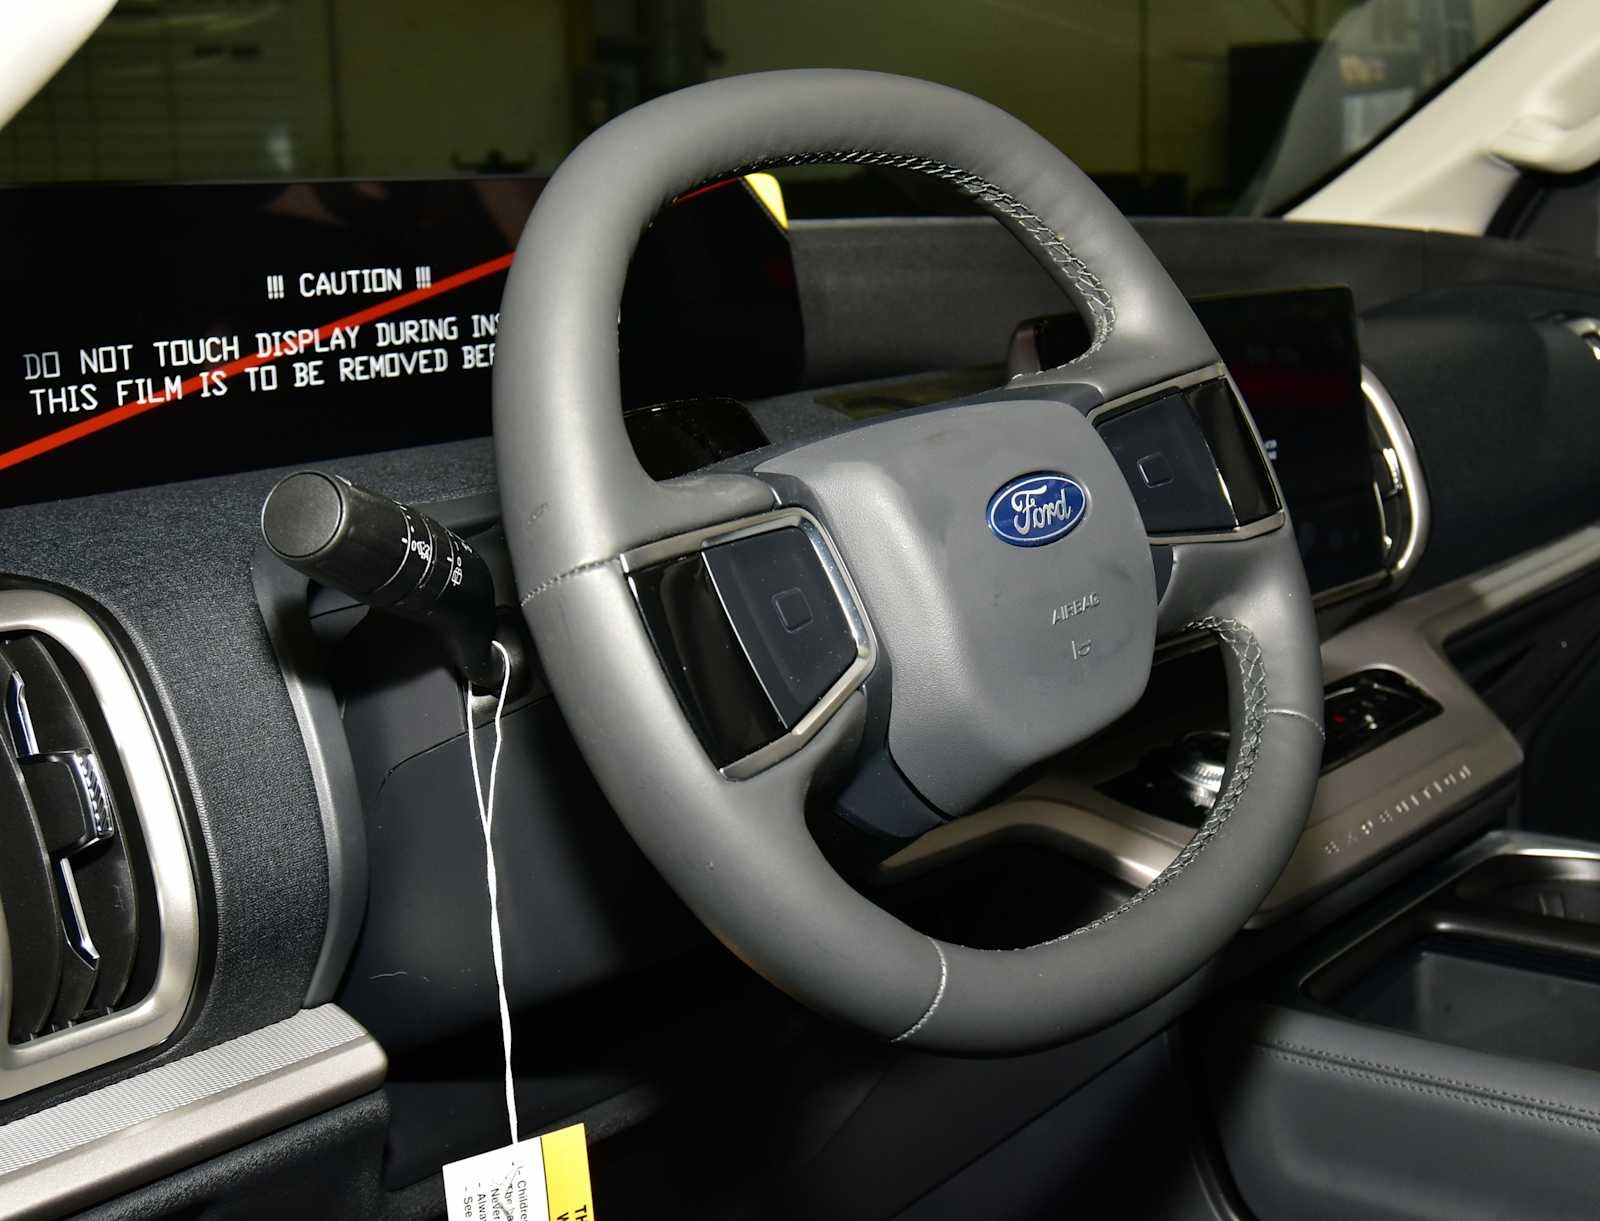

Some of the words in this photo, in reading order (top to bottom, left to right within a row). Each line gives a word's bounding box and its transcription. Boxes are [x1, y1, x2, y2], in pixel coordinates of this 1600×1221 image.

[299, 267, 403, 297] CAUTION
[23, 352, 60, 380] DO
[80, 345, 133, 375] NOT
[153, 335, 240, 368] TOUCH
[255, 325, 360, 359] DISPLAY
[375, 317, 459, 347] DURING
[29, 384, 98, 415] THIS
[117, 375, 182, 407] FILM
[199, 370, 227, 397] IS
[244, 365, 277, 392] TO
[293, 360, 324, 388] BE
[339, 348, 448, 381] REMOVED
[1011, 484, 1072, 536] Ford
[1052, 591, 1100, 624] AIRBAG
[463, 1196, 473, 1218] See
[490, 1188, 500, 1220] Never
[517, 1179, 529, 1221] Childre
